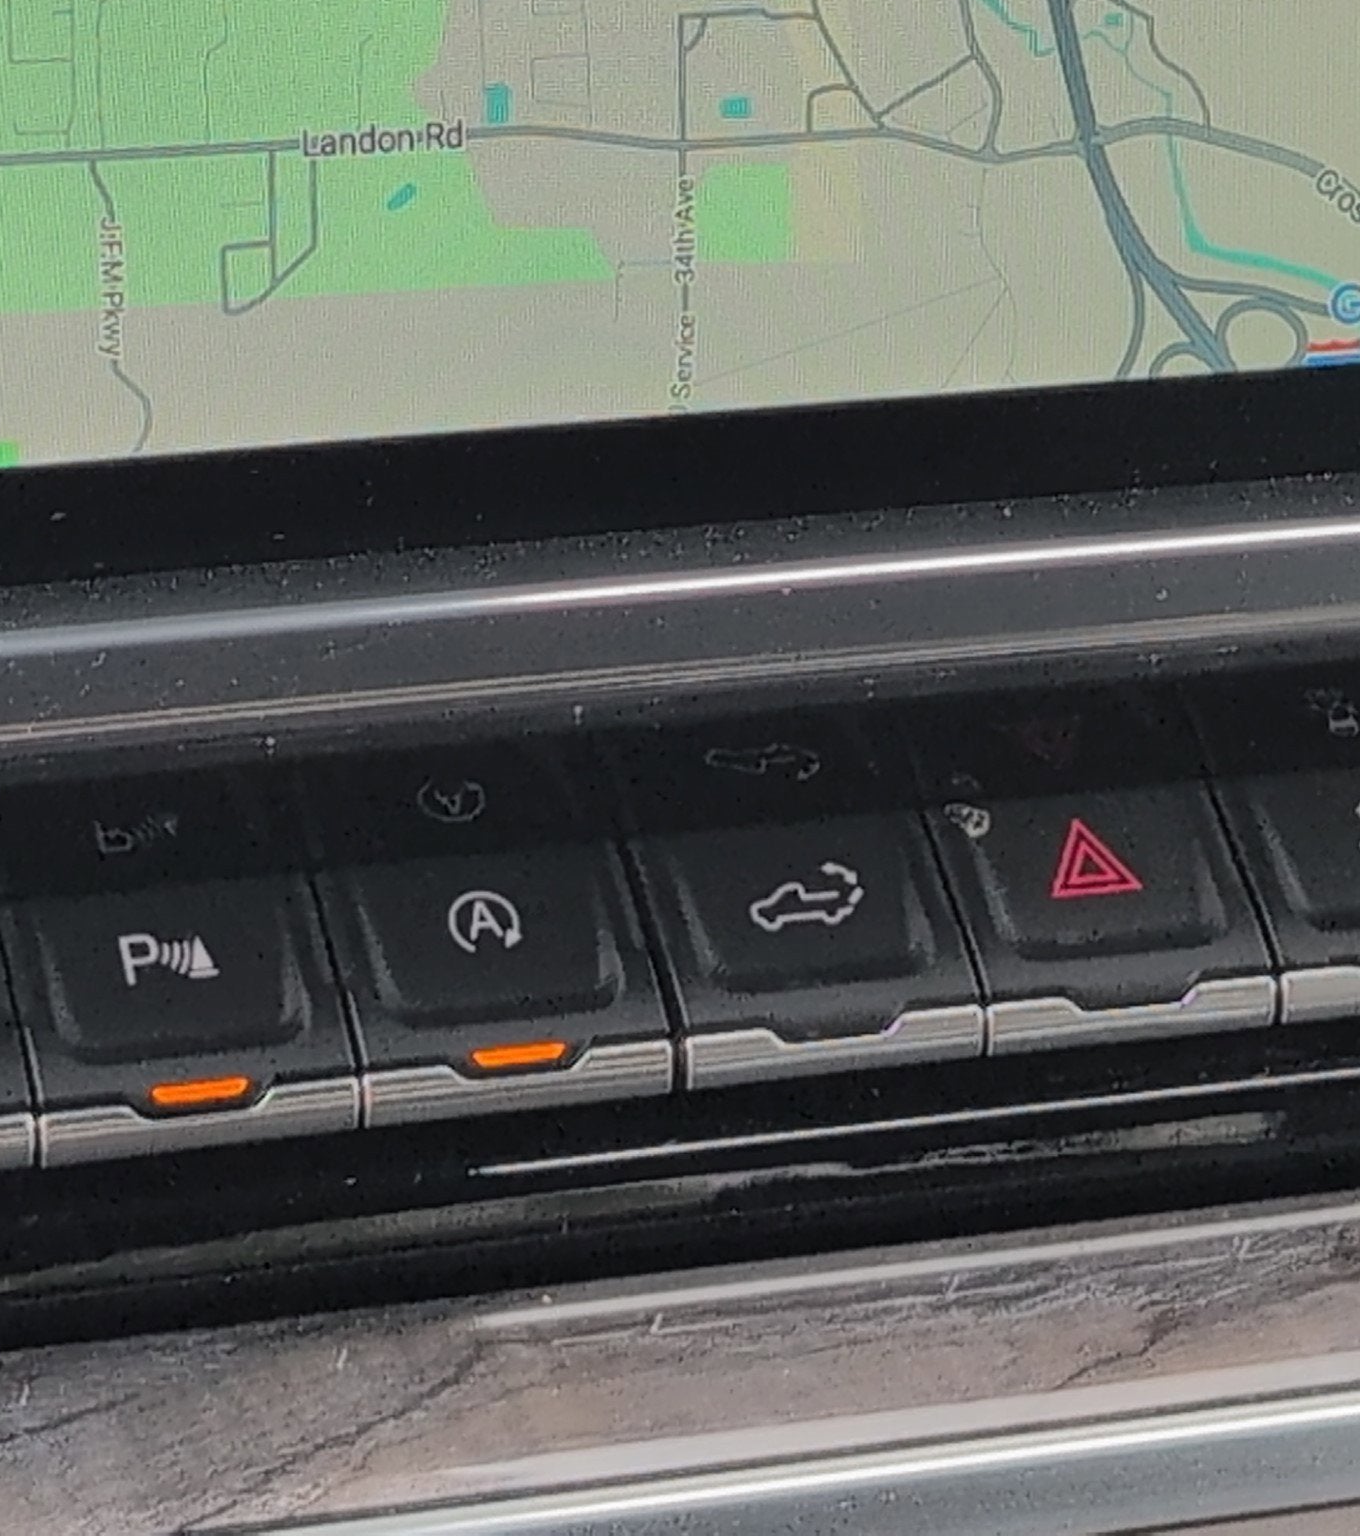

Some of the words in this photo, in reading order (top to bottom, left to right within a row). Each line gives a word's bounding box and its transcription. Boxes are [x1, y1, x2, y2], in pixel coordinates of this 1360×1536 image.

[302, 123, 415, 157] Landon
[426, 118, 464, 151] Rd
[673, 177, 695, 224] Ave
[673, 231, 695, 285] 34th
[97, 291, 125, 357] Pkwy
